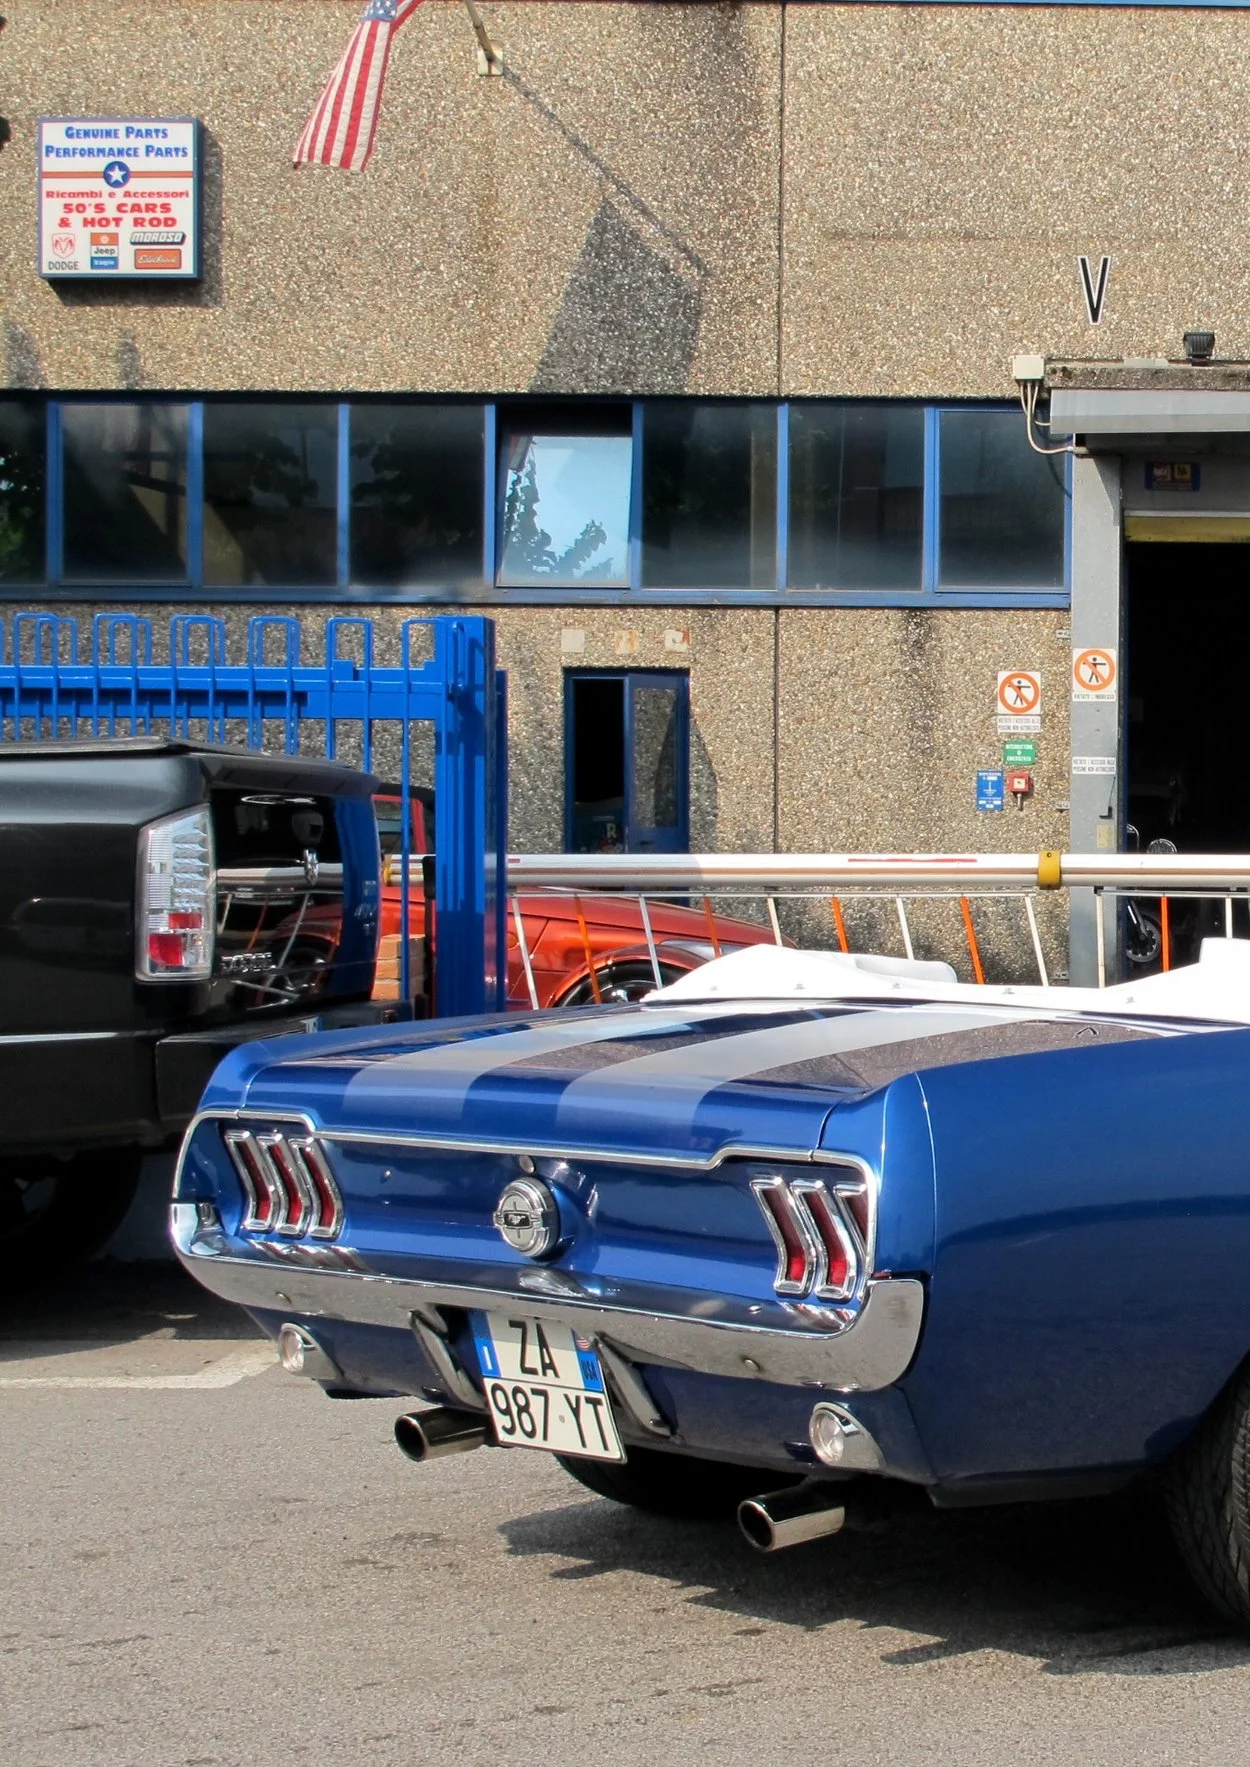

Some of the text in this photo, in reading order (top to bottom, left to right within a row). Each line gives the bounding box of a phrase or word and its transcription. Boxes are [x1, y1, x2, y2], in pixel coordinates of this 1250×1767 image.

[65, 126, 168, 139] GENUINE PARTS
[45, 145, 188, 158] PERFORMANCE PARTS
[46, 190, 102, 198] Ricambi
[123, 190, 189, 198] Accessori
[116, 203, 172, 213] CARS
[58, 217, 177, 228] & HOT ROD
[131, 232, 184, 243] MOROSO
[94, 247, 115, 256] Jeep
[48, 261, 79, 270] DODGE
[508, 1320, 560, 1379] ZA
[582, 1359, 598, 1381] USA
[491, 1382, 609, 1452] 987 YT
